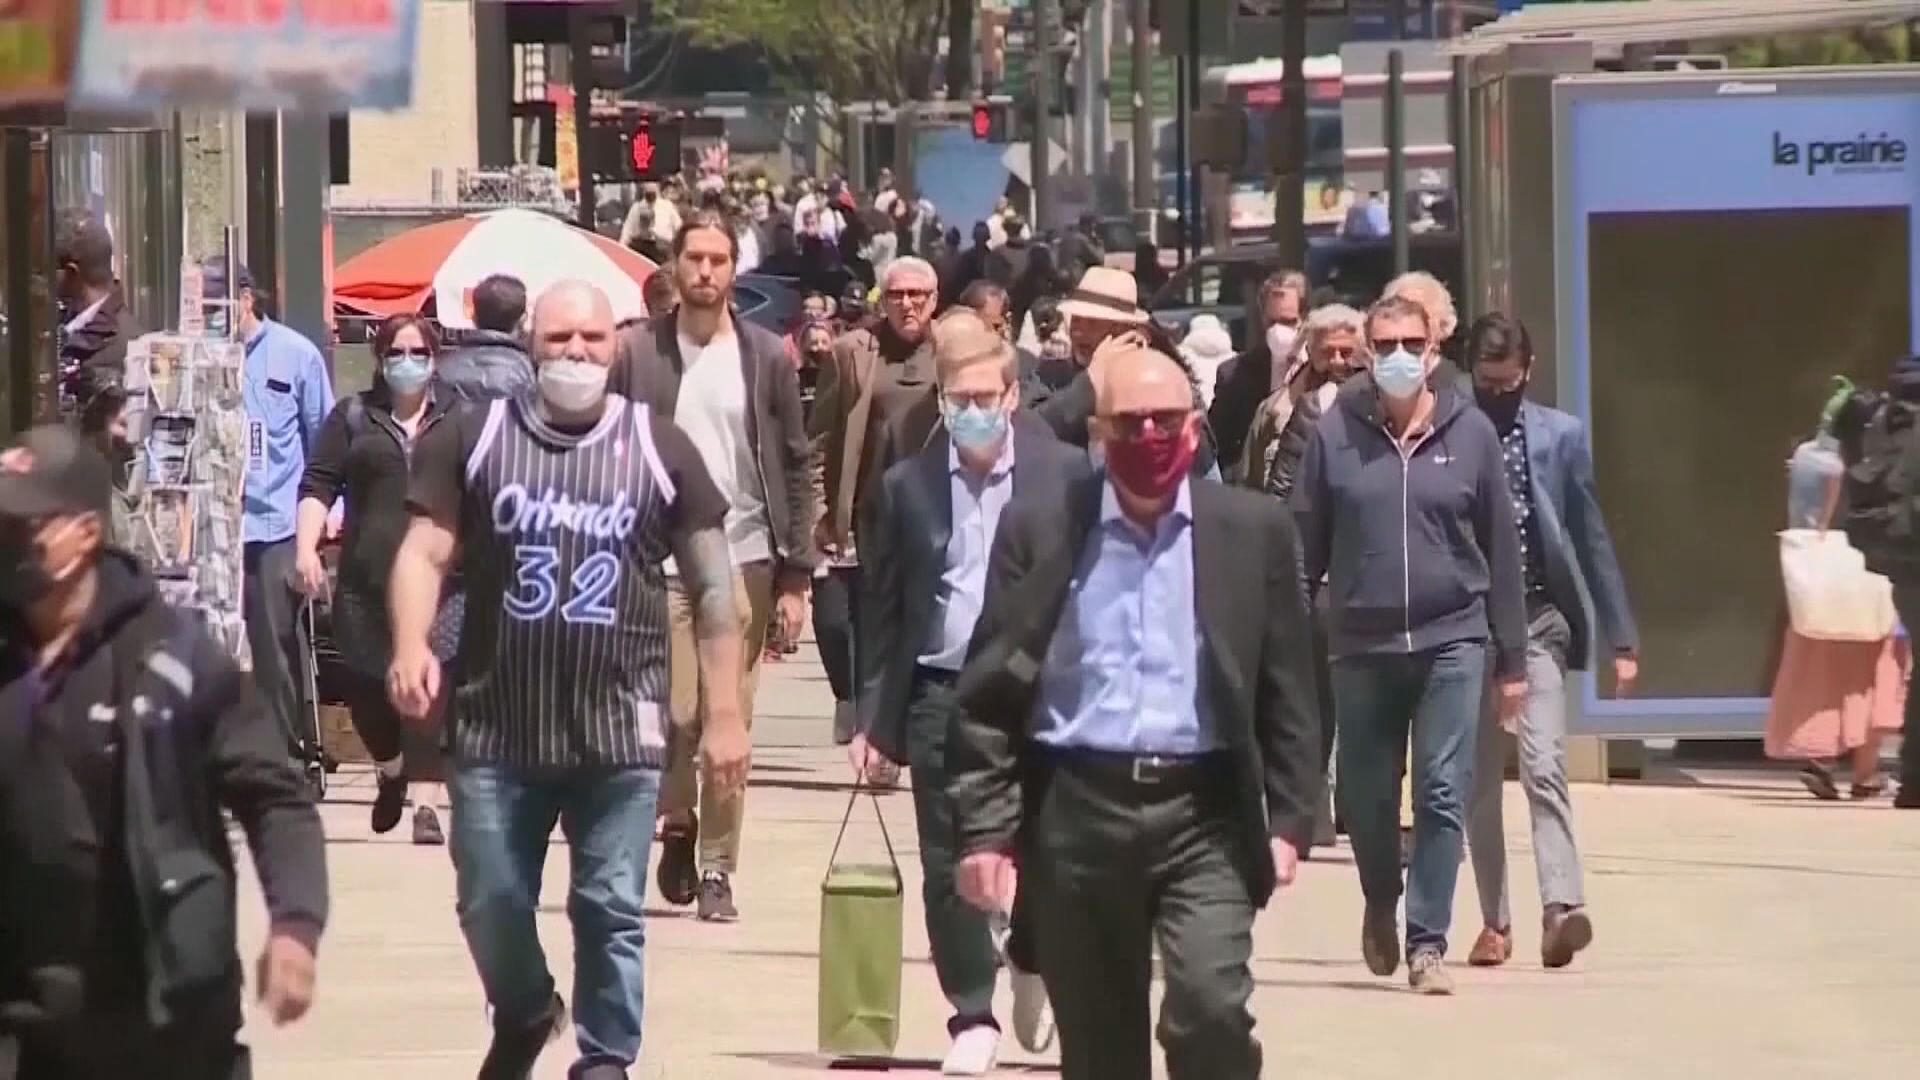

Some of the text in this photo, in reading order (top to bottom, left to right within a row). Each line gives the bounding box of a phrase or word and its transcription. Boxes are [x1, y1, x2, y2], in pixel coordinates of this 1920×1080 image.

[1773, 131, 1907, 176] la prairie
[503, 545, 619, 625] 32
